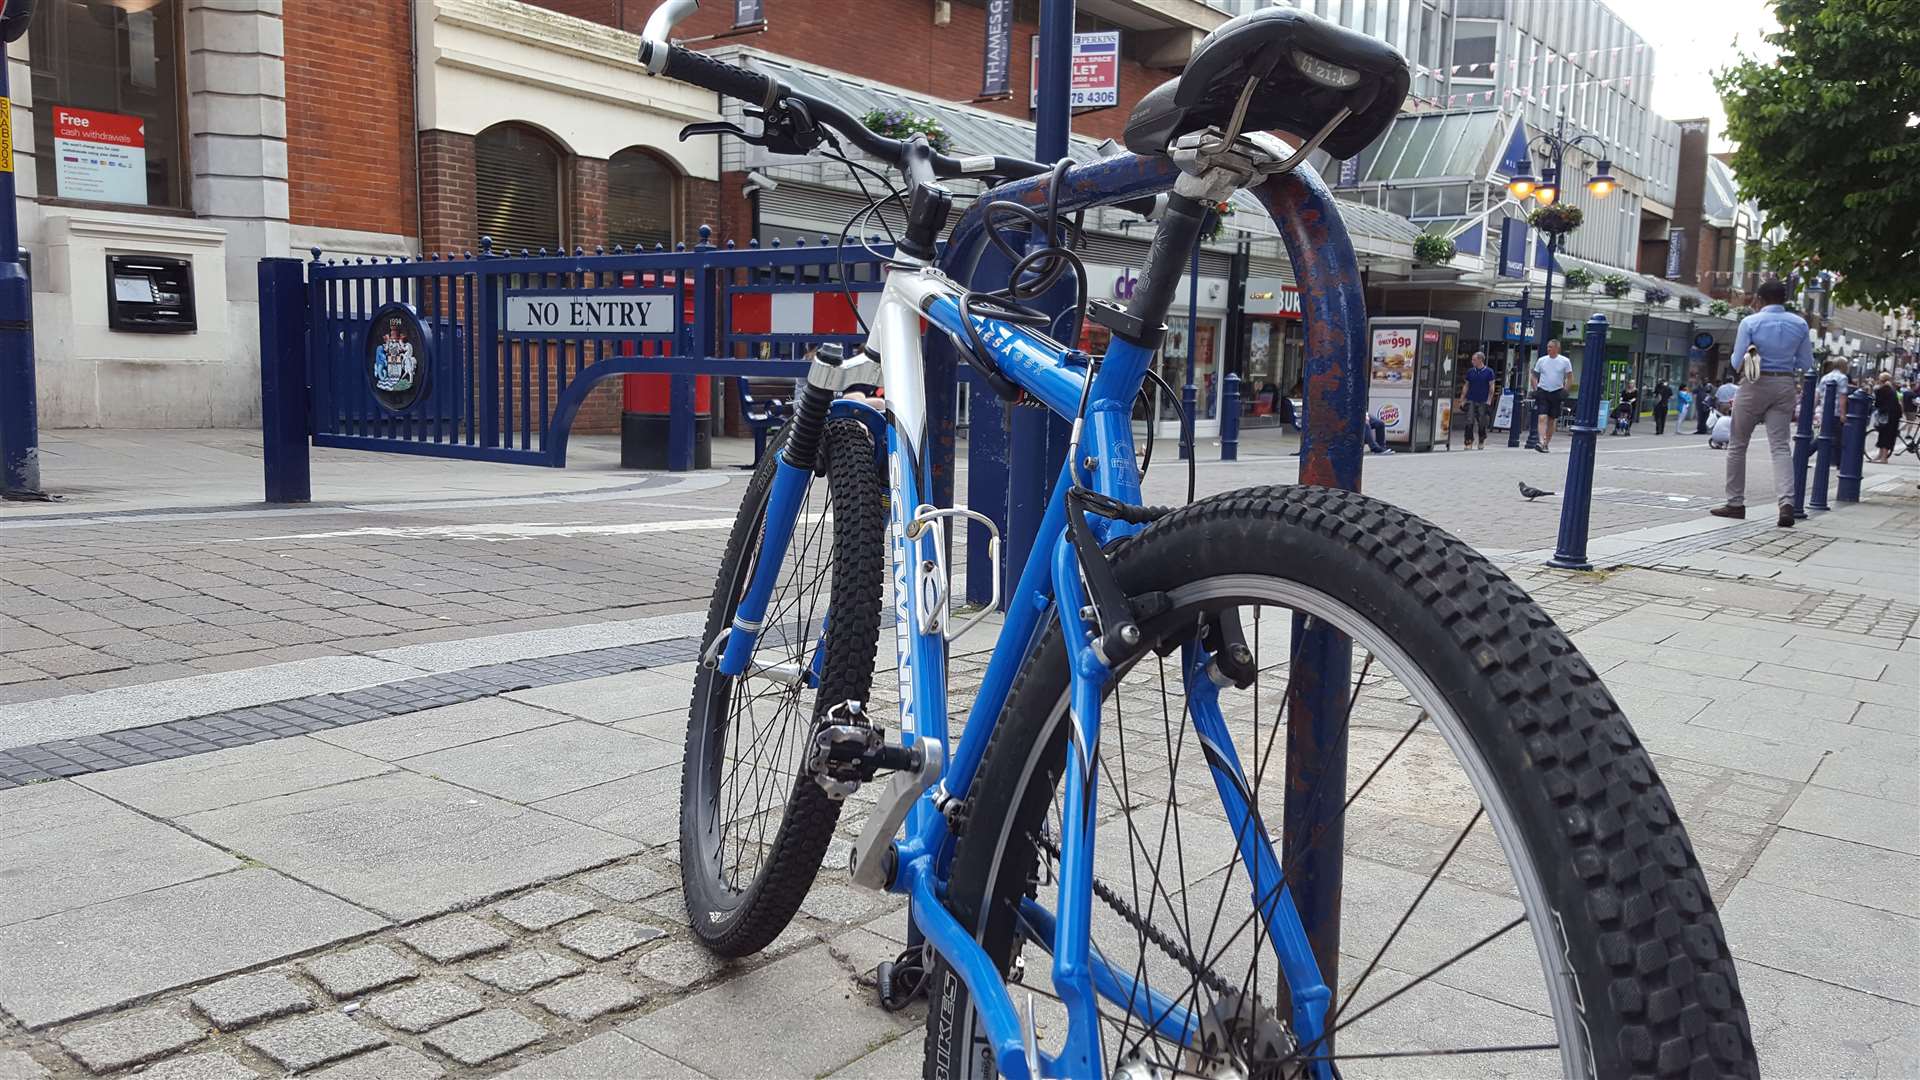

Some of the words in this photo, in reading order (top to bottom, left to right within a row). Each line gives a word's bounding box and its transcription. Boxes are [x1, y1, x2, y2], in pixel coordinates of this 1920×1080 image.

[1081, 35, 1117, 44] PERKINS
[1073, 65, 1098, 75] LET
[1071, 92, 1084, 104] 78
[1087, 91, 1115, 103] 4306
[60, 111, 90, 127] Free
[60, 128, 81, 137] cash
[82, 131, 132, 144] withdrawals
[527, 302, 559, 326] NO
[570, 301, 652, 327] ENTRY
[1391, 336, 1412, 349] 99p
[889, 450, 915, 734] SCHWINN
[935, 970, 958, 1080] BIKES
